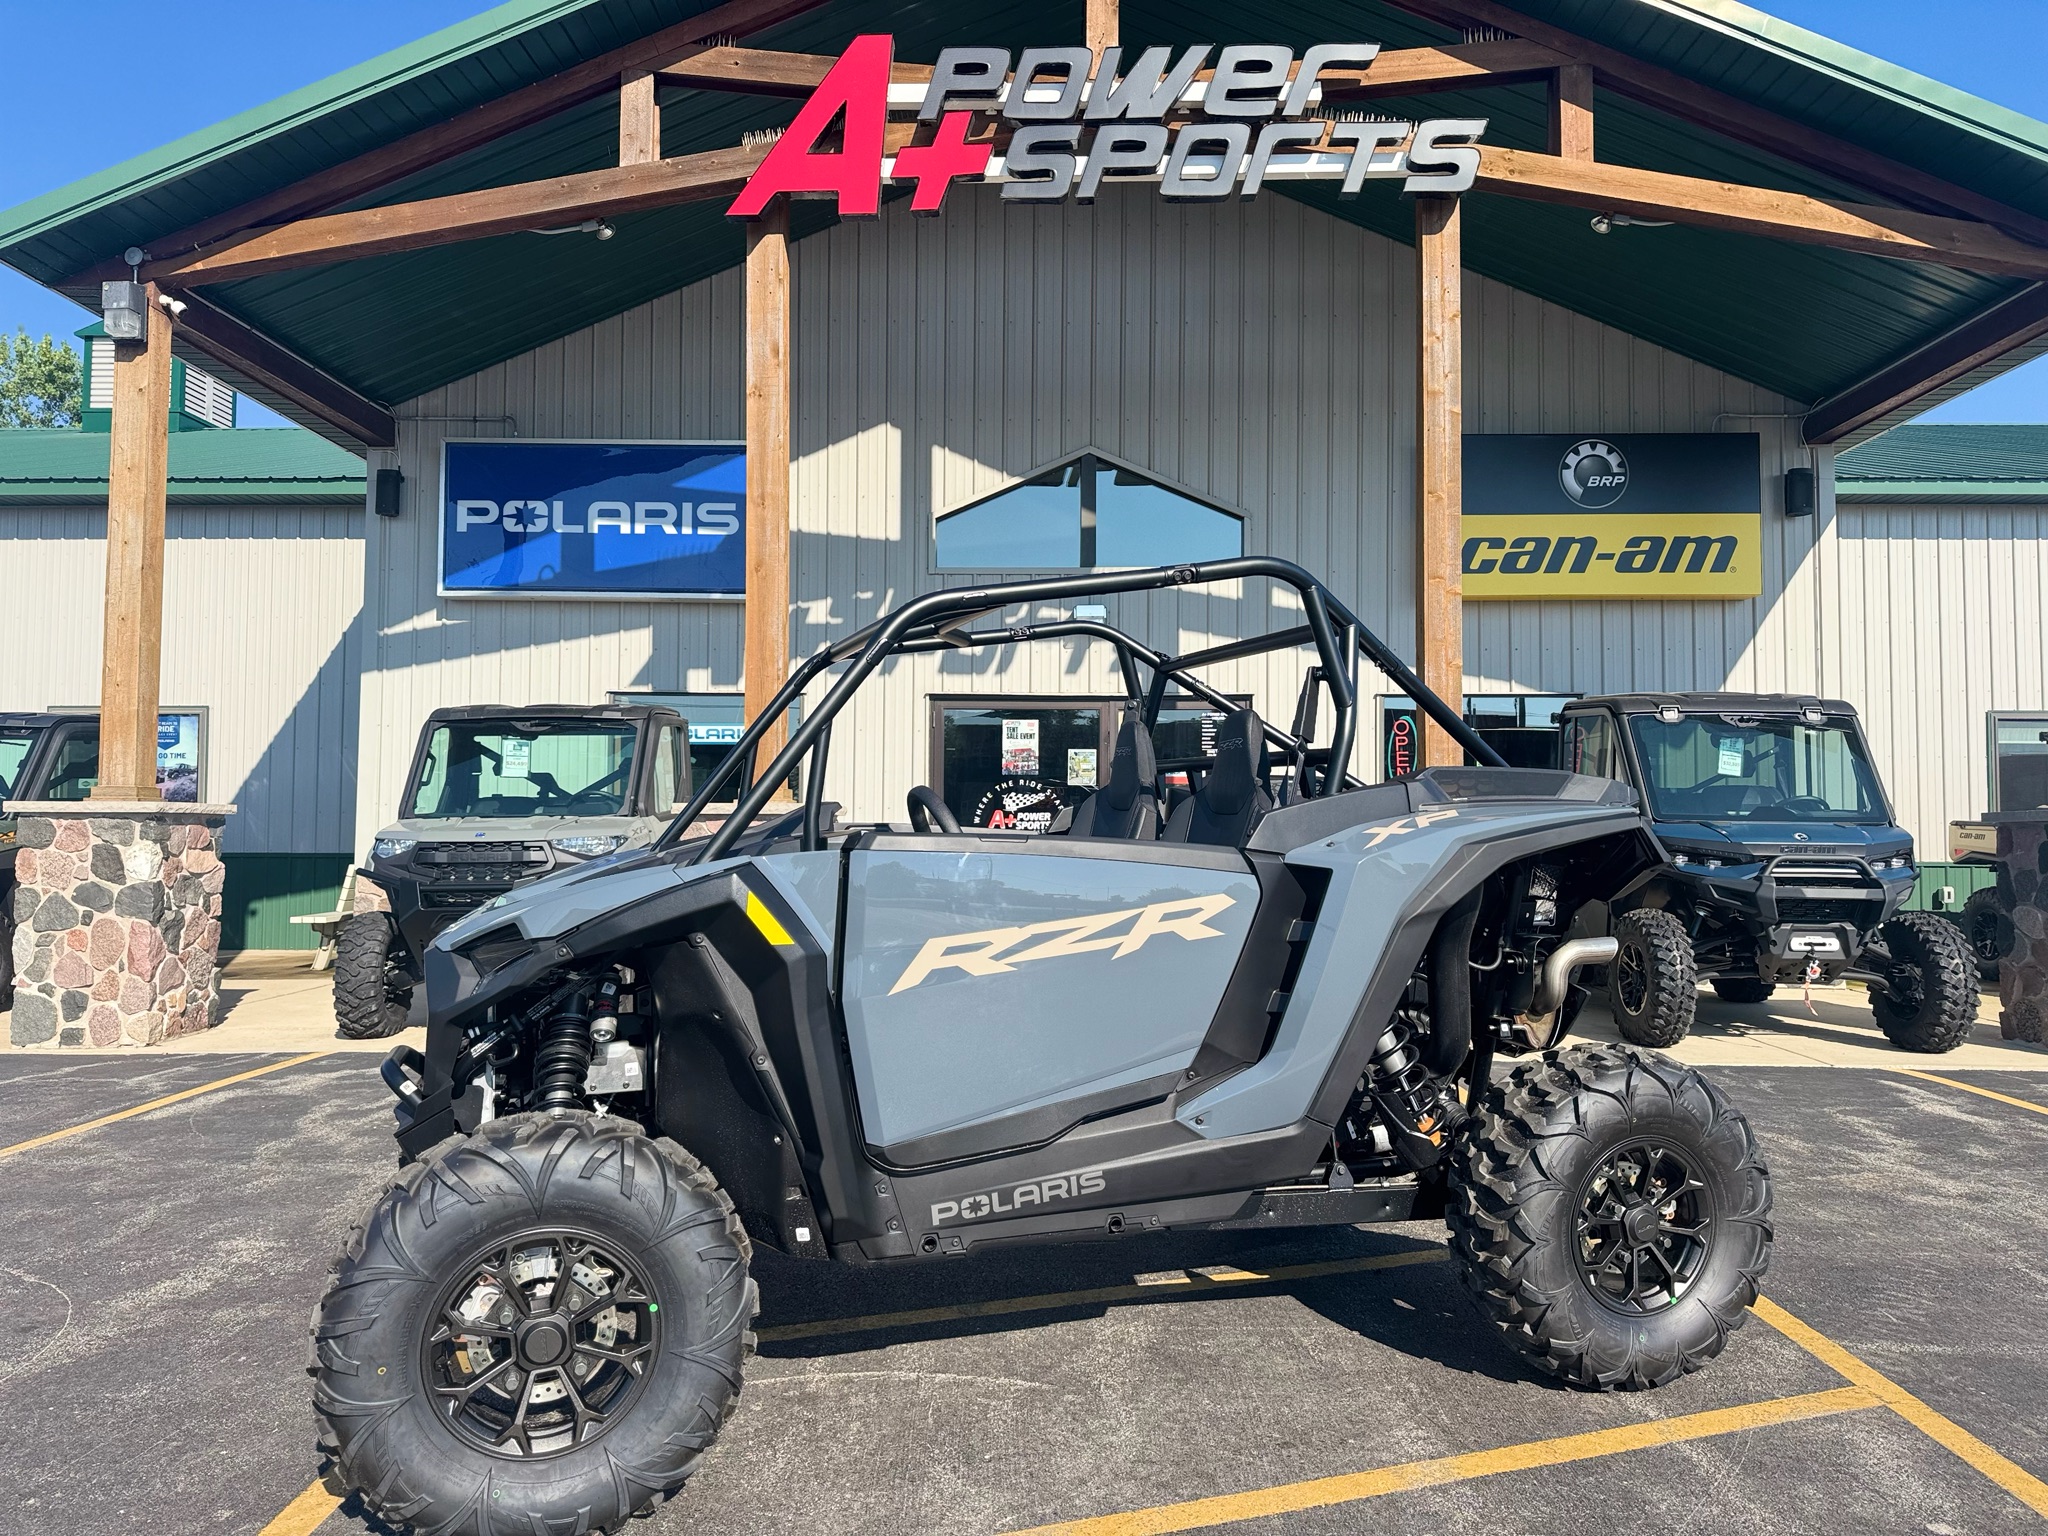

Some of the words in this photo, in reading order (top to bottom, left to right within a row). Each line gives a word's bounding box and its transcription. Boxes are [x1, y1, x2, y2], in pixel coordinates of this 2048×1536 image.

[1587, 475, 1626, 487] BRP
[456, 499, 739, 536] POLARIS
[157, 725, 175, 733] RIDE
[688, 728, 747, 740] LARI
[973, 791, 994, 824] WHERE
[994, 779, 1014, 792] THE
[1019, 779, 1043, 791] RIDE
[1045, 788, 1065, 810] STAR
[987, 809, 1017, 829] A+
[1017, 812, 1052, 821] POWER
[631, 825, 646, 836] XP
[1361, 809, 1460, 850] XP
[1959, 832, 1986, 840] can-am
[1780, 845, 1837, 854] can-am
[887, 893, 1237, 997] RZR
[930, 1169, 1106, 1226] POLARIS
